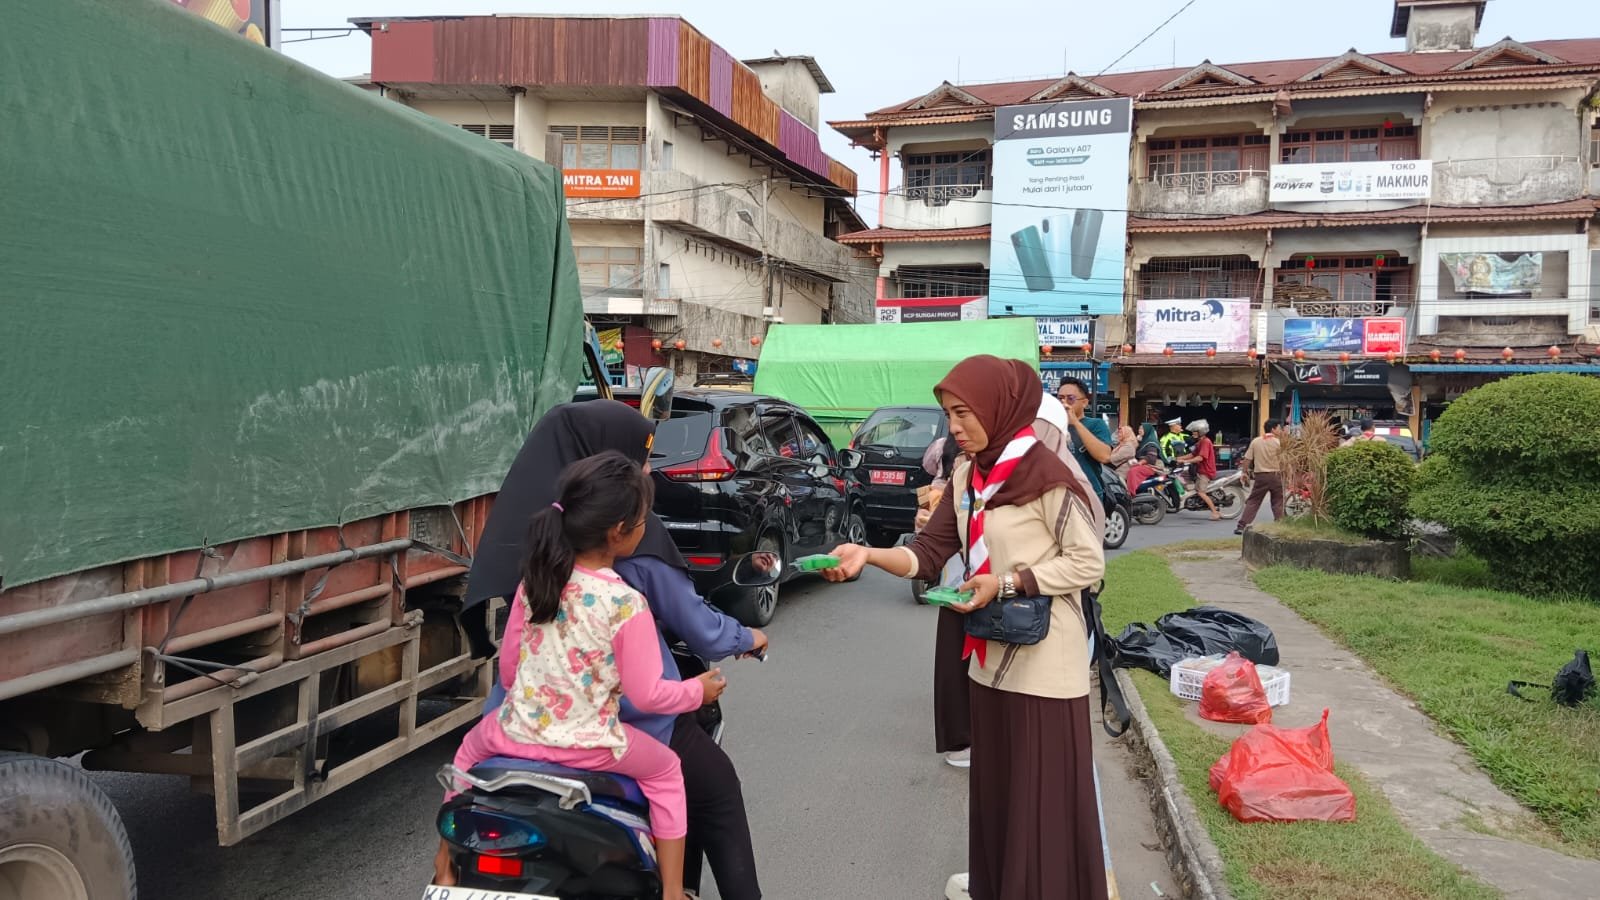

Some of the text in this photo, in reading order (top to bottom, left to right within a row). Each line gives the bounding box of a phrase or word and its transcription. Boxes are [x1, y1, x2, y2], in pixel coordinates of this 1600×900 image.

[1012, 108, 1113, 131] SAMSUNG
[1046, 145, 1076, 154] Galaxy
[1077, 144, 1092, 152] A07
[563, 175, 634, 186] MITRA TANI
[1273, 181, 1314, 190] POWER
[1376, 174, 1429, 188] MAKMUR
[1022, 185, 1043, 193] Mulai
[1044, 184, 1060, 192] dari
[1156, 306, 1201, 322] Mitra
[1059, 323, 1089, 334] DUNIA
